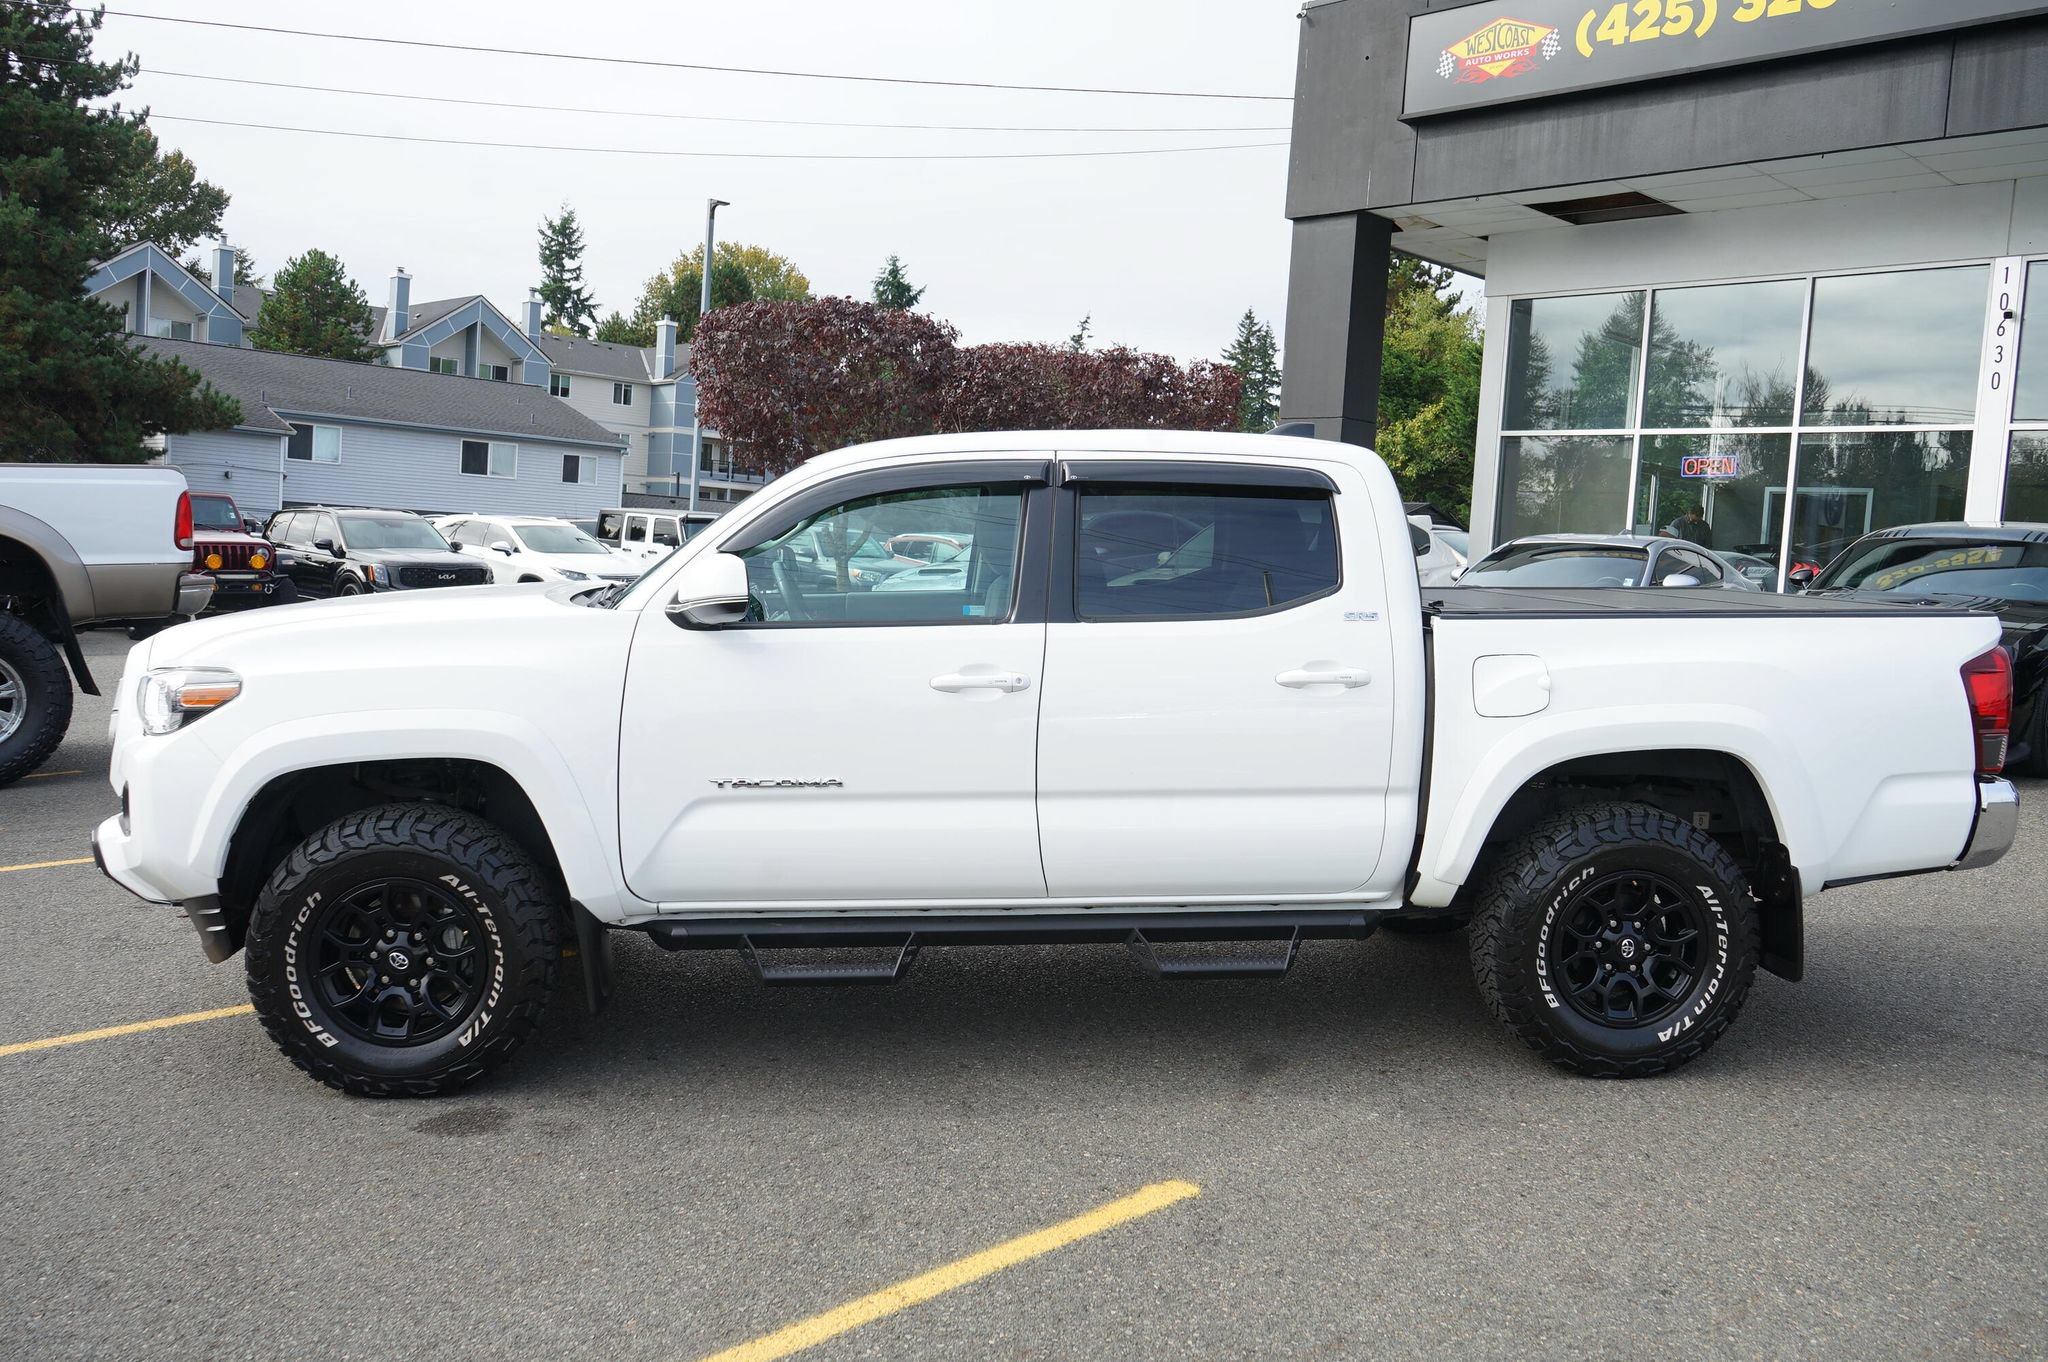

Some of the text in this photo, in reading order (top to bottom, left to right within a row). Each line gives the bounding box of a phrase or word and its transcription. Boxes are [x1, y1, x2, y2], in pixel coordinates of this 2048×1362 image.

[1465, 56, 1492, 67] AUTO
[1494, 48, 1530, 62] WORKS
[1575, 0, 1718, 58] (425)
[1991, 266, 2010, 390] 10630
[1684, 457, 1735, 475] OPEN
[708, 777, 843, 789] TACOMA
[284, 891, 341, 1048] BFGoodrich
[439, 873, 505, 1048] All-Terrain T/A
[1536, 866, 1595, 1009] BFGoodrich
[1657, 884, 1729, 1043] All-Terrain T/A
